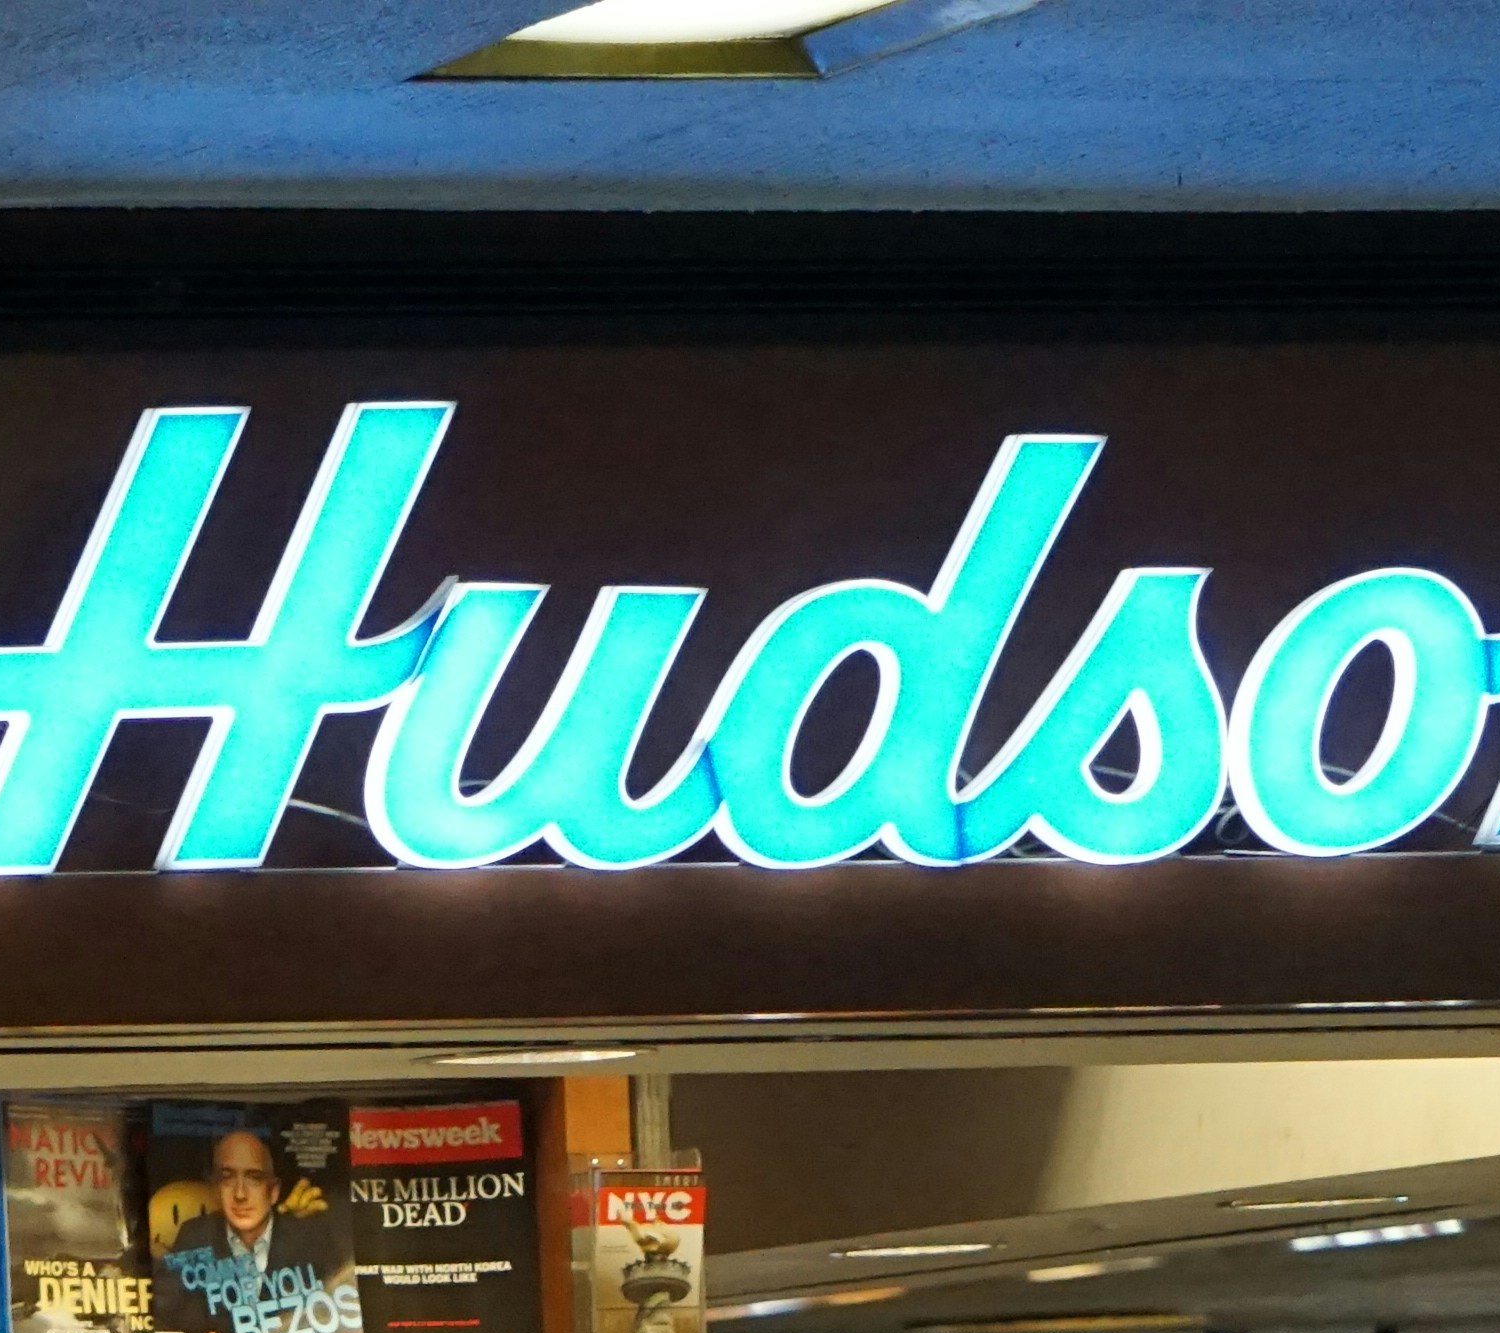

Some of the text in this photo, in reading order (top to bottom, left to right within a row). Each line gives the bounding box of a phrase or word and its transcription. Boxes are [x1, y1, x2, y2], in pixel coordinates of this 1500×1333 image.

[382, 1202, 467, 1228] DEAD
[606, 1191, 695, 1222] NYC
[24, 1260, 95, 1277] WHO'S A
